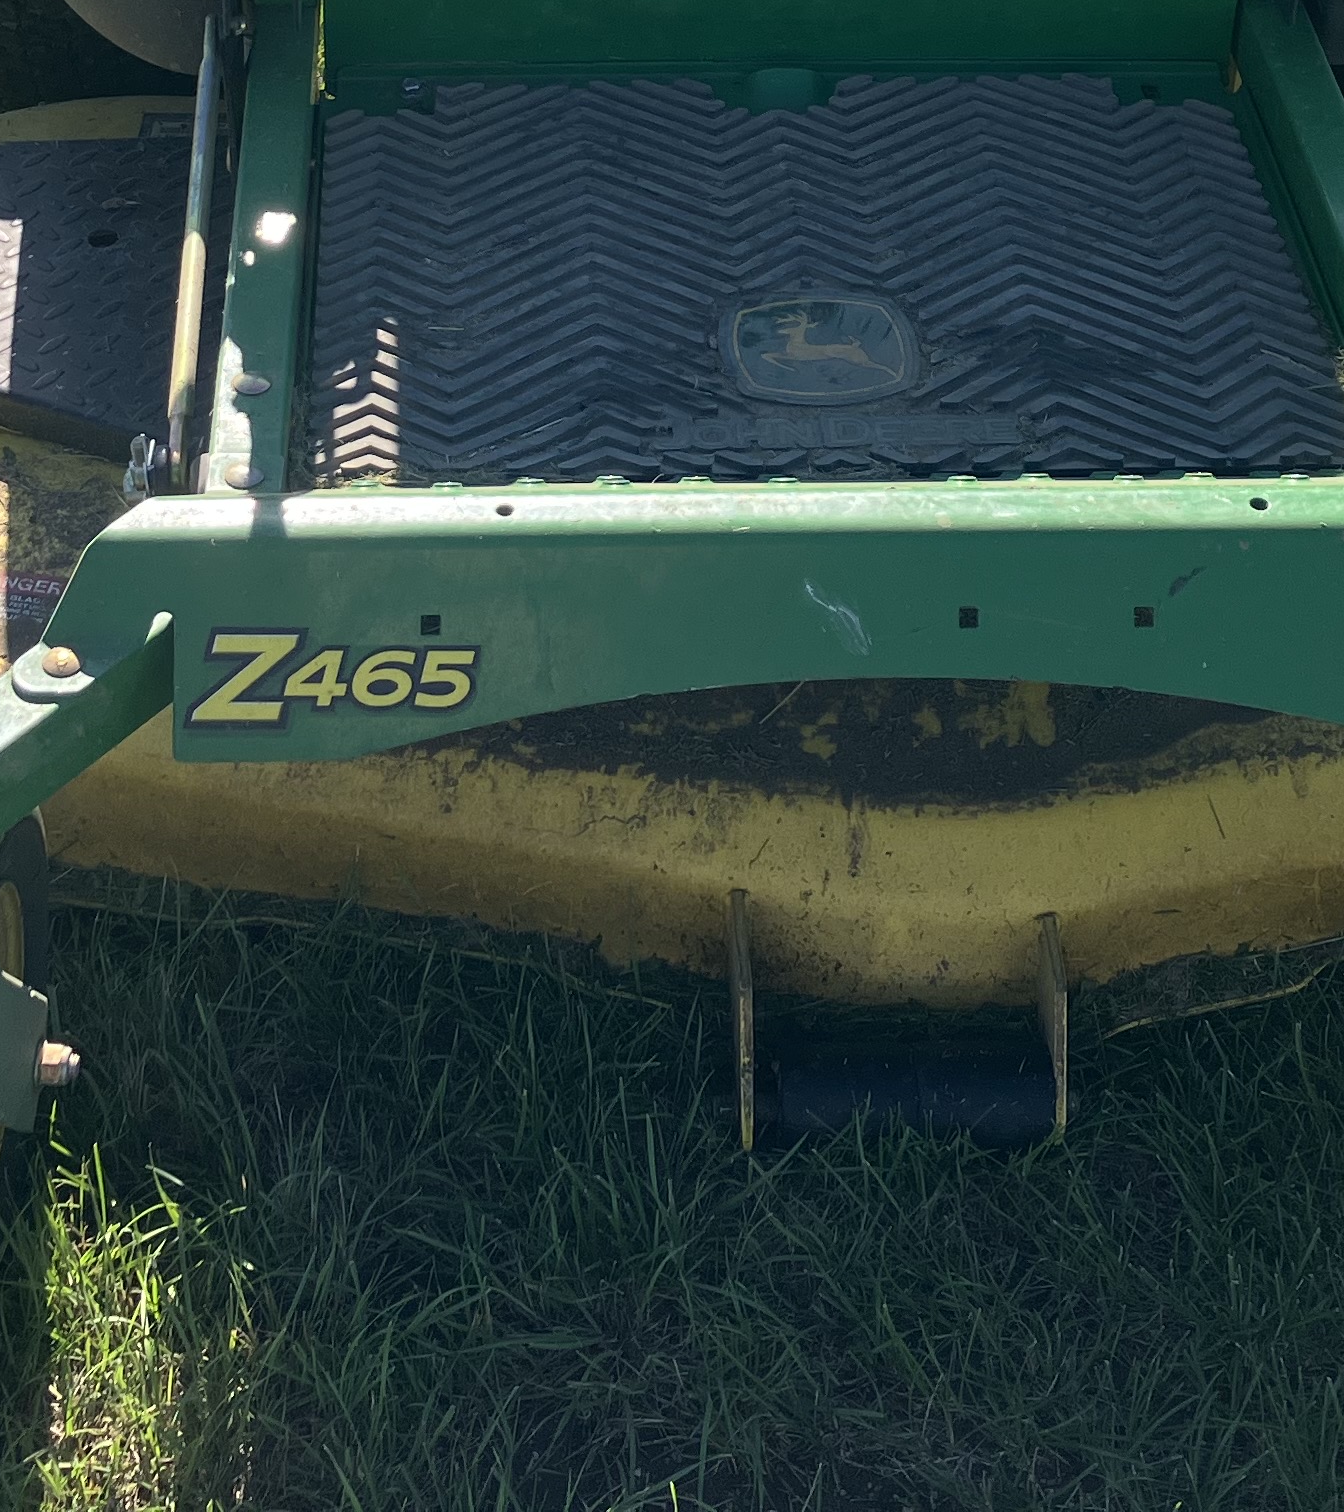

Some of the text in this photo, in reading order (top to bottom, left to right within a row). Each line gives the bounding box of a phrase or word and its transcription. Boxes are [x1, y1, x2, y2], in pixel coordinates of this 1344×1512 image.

[652, 414, 1022, 449] JOHN DEERE
[187, 631, 478, 725] Z465
